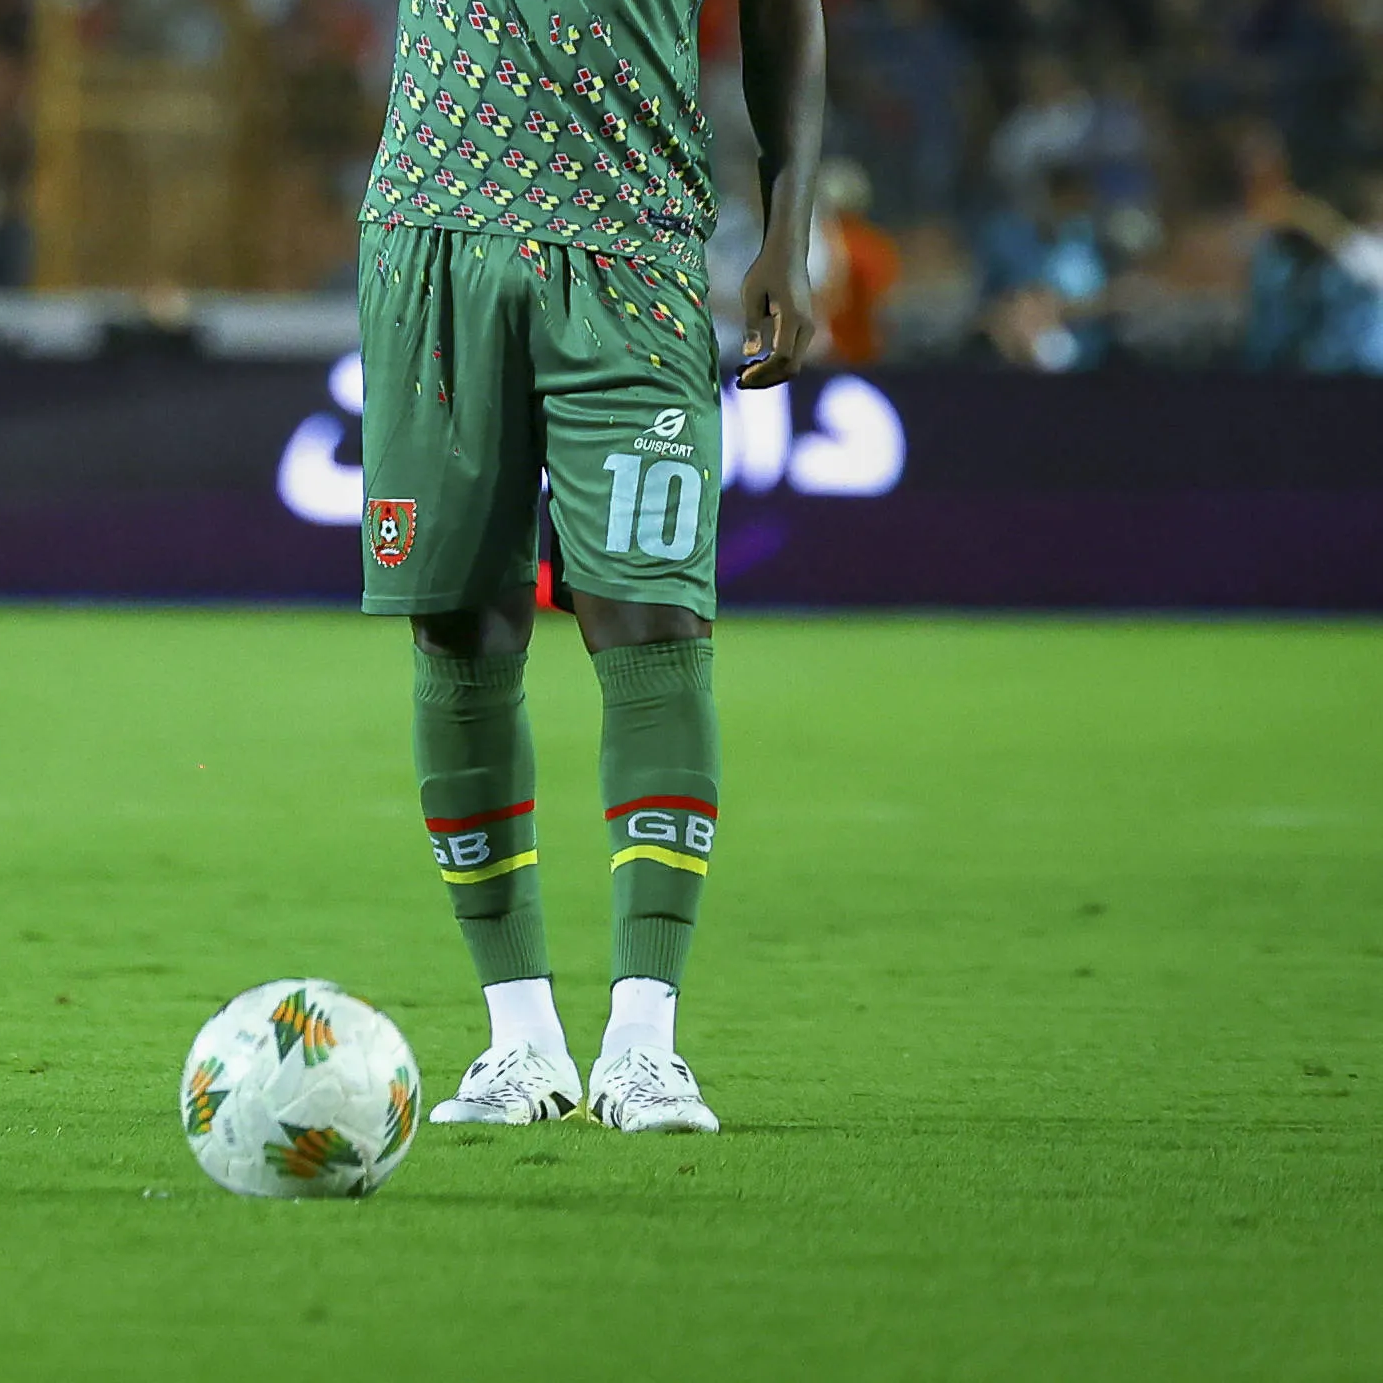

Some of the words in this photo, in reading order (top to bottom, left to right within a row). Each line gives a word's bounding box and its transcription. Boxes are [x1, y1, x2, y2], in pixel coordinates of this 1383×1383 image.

[633, 436, 695, 458] GUISPORT
[602, 452, 702, 561] 10
[627, 810, 714, 854] GB
